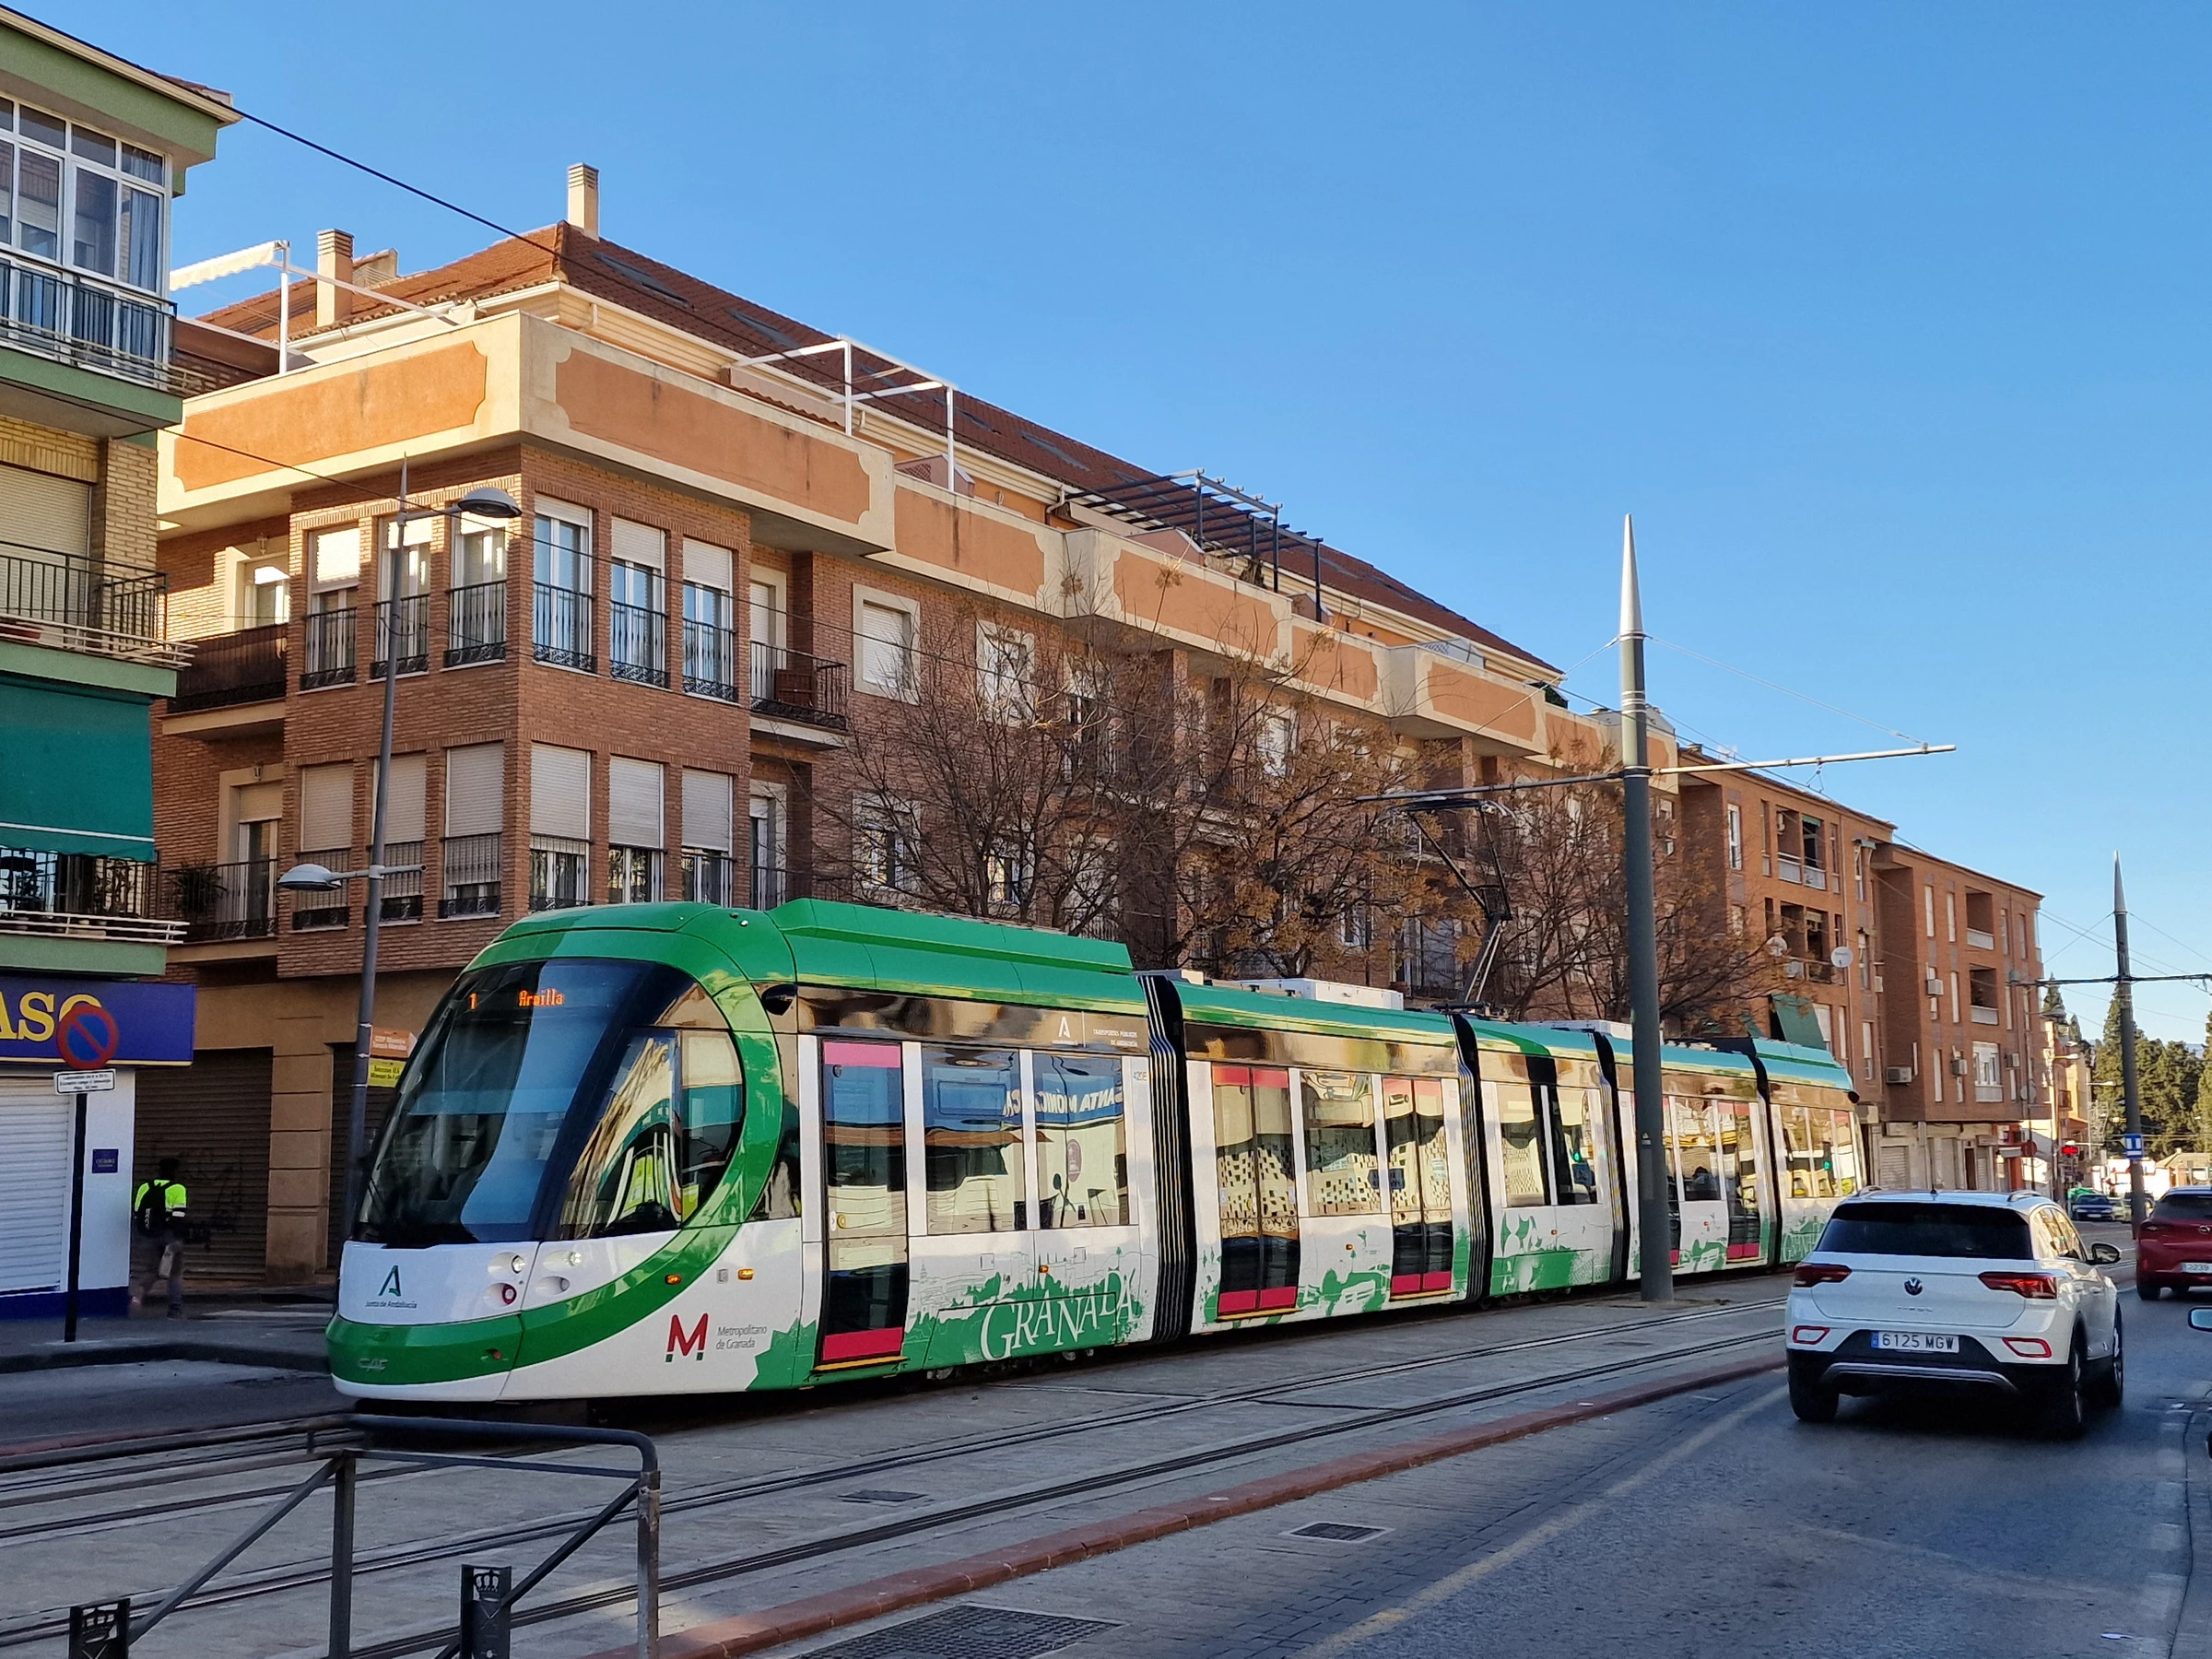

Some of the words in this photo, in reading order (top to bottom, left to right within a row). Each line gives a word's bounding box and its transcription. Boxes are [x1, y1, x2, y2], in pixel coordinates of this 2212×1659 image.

[469, 993, 477, 1010] 1
[982, 1271, 1140, 1360] GRANADA
[717, 1324, 767, 1337] Metropolitano
[716, 1339, 724, 1349] de
[726, 1338, 756, 1348] Granada
[1883, 1334, 1920, 1347] 6125
[1925, 1335, 1954, 1349] MGW
